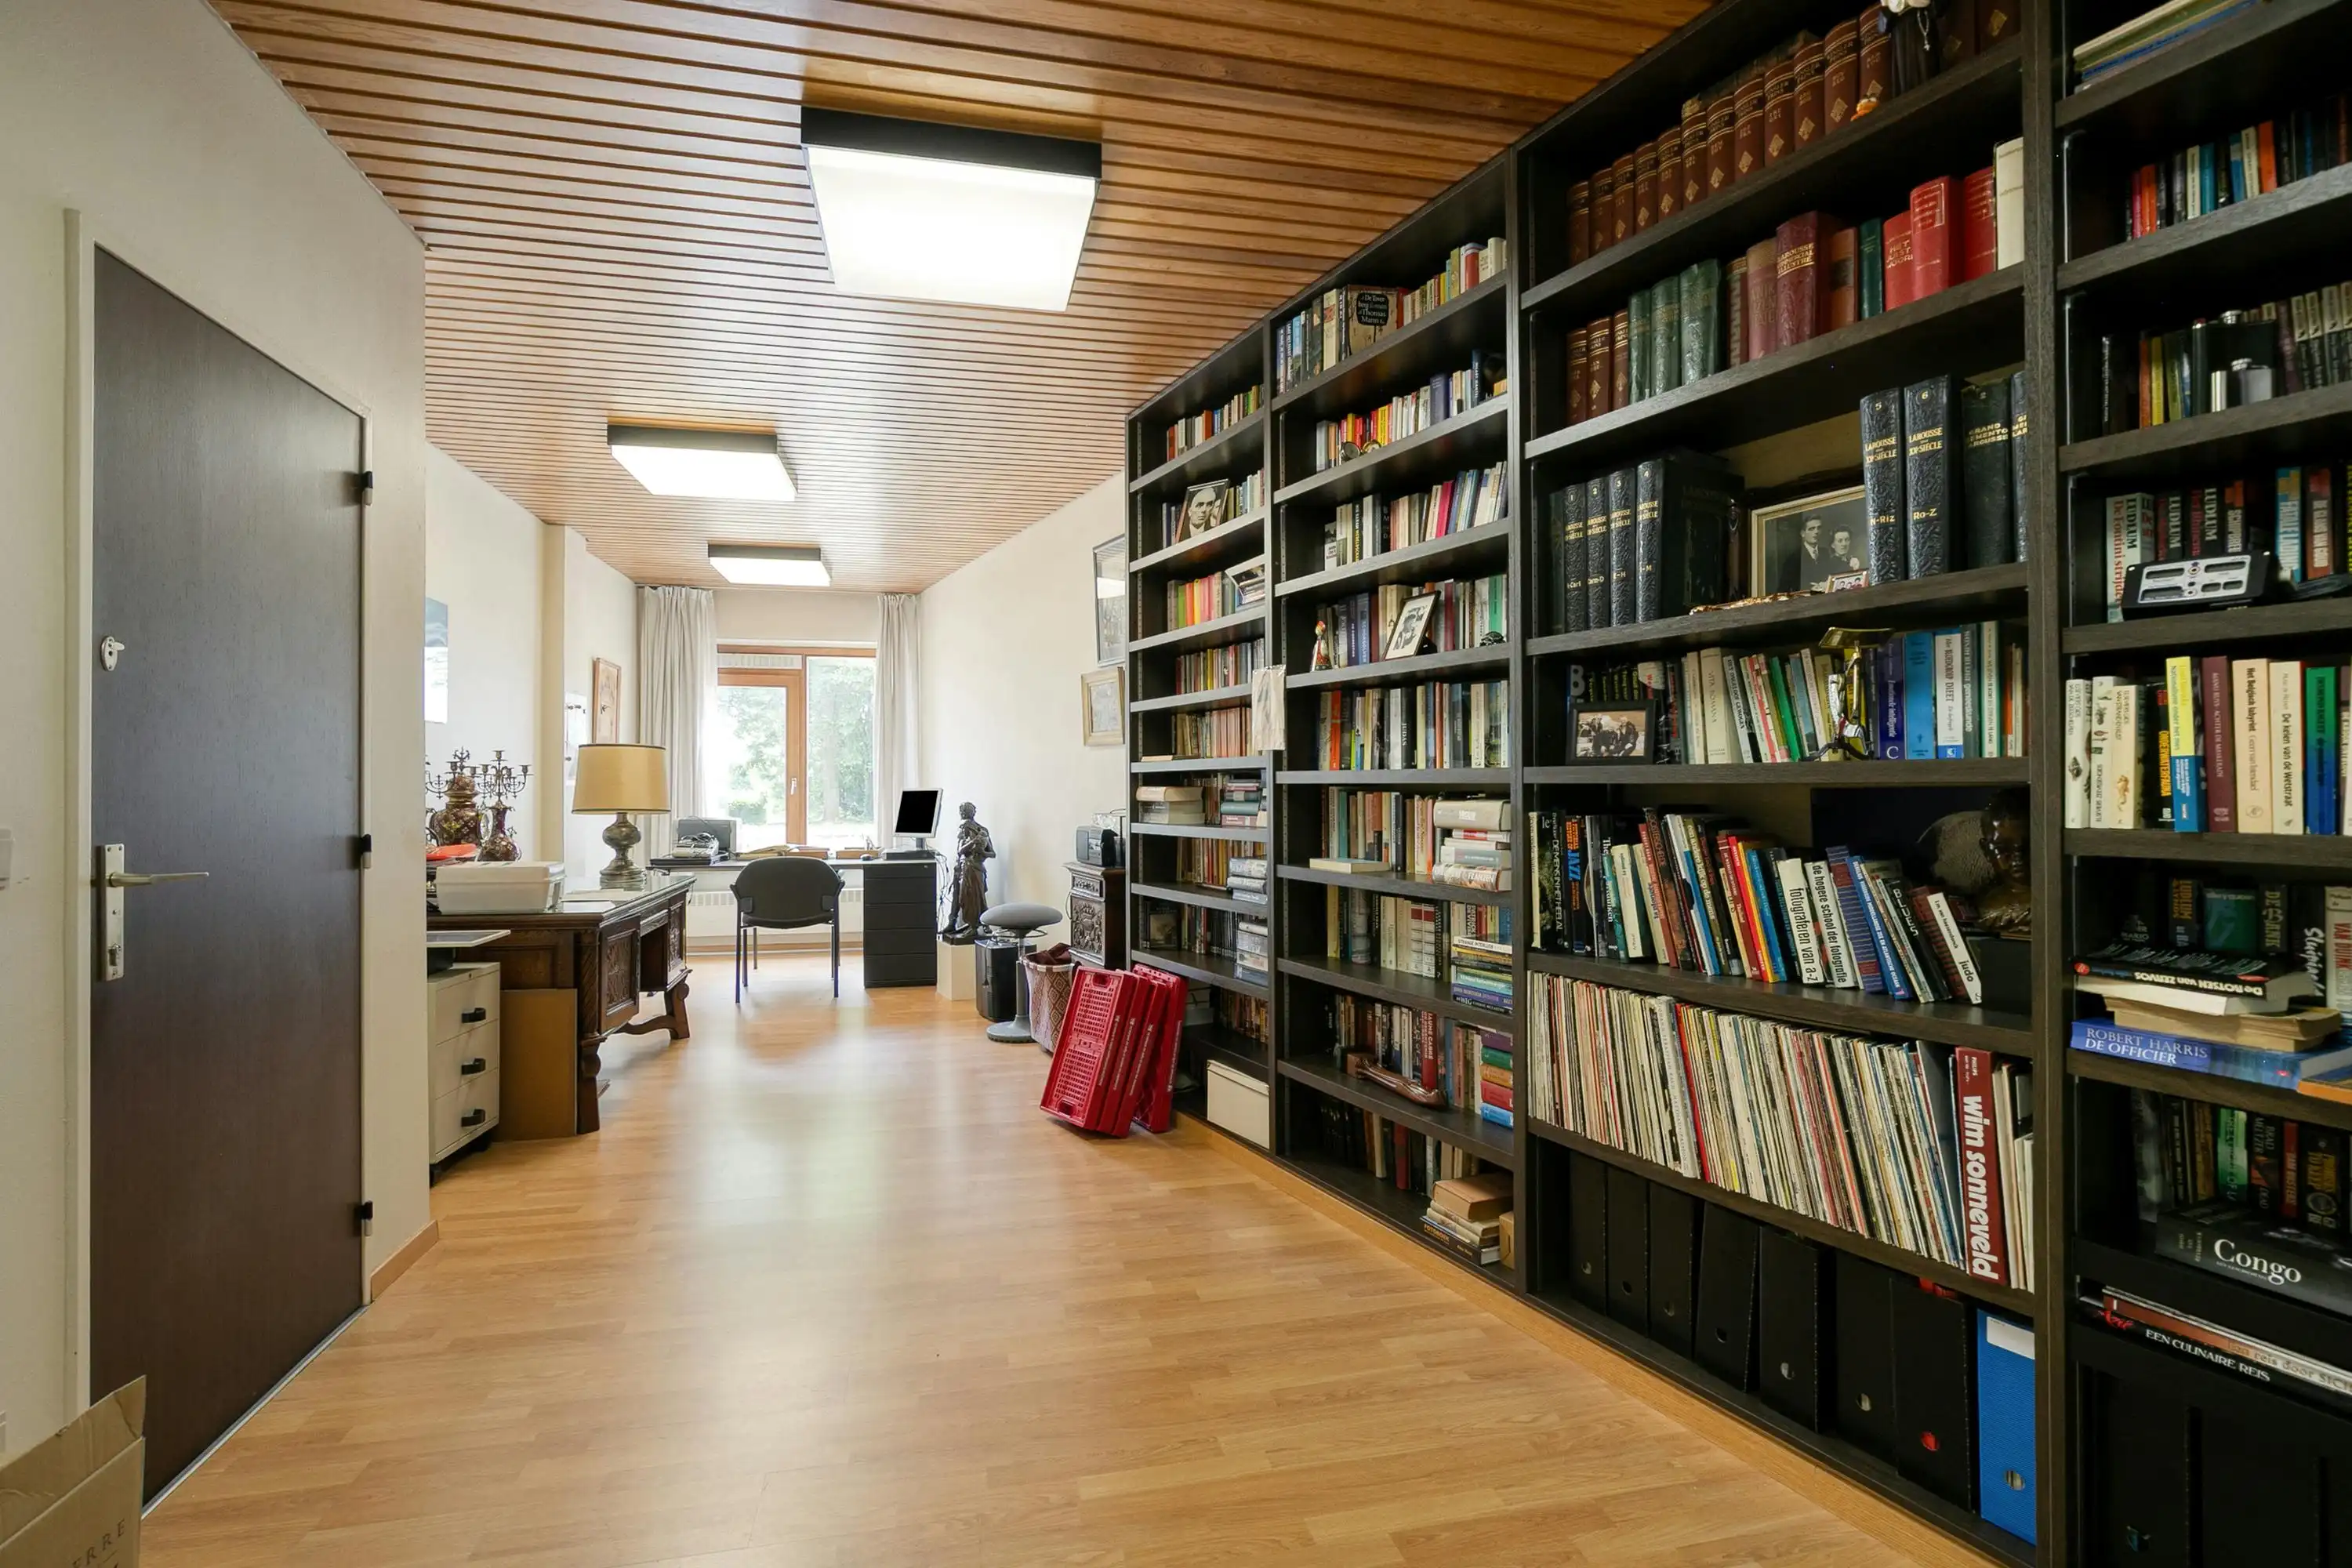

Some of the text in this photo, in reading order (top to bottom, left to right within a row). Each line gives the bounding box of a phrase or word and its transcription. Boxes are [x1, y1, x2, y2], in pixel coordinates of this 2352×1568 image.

[1875, 401, 1882, 411] 5
[1921, 390, 1929, 400] 6
[1864, 436, 1897, 452] LAROUSSE
[1908, 426, 1944, 444] LAROUSSE
[1913, 507, 1937, 521] Ro-Z
[2126, 497, 2137, 550] LUDLUM
[2169, 495, 2182, 549] LUDLUM
[2205, 487, 2218, 541] LUDLUM
[2227, 509, 2243, 554] SCHIPBREU
[2247, 668, 2256, 679] Het
[1945, 682, 1955, 702] DIEET
[2245, 680, 2256, 706] Belgisch
[1963, 683, 1973, 732] geneeskunde
[2246, 707, 2257, 732] labyrint
[2282, 713, 2291, 724] De
[2282, 724, 2292, 745] keien
[2285, 761, 2293, 770] de
[2285, 771, 2293, 807] Wetstraat
[1568, 851, 1581, 881] JAZZ
[1694, 863, 1704, 878] kijk
[1703, 890, 1711, 898] de
[1705, 900, 1715, 920] mens
[1736, 903, 1745, 924] Thailand
[1893, 888, 1920, 937] BLUES
[1788, 887, 1818, 982] fotograferen van a-z
[1812, 865, 1849, 983] de hogere school der fotografie
[2334, 923, 2352, 940] VAN
[1958, 960, 1975, 982] judo
[2134, 971, 2263, 996] De ROTSEN van ZERVOS
[2085, 1037, 2177, 1065] DE OFFICIER
[2086, 1027, 2209, 1059] ROBERT HARRIS
[1963, 1094, 2000, 1280] wim sonneveld
[2213, 1239, 2303, 1286] Congo
[2144, 1329, 2271, 1383] EEN CULINAIRE REIS
